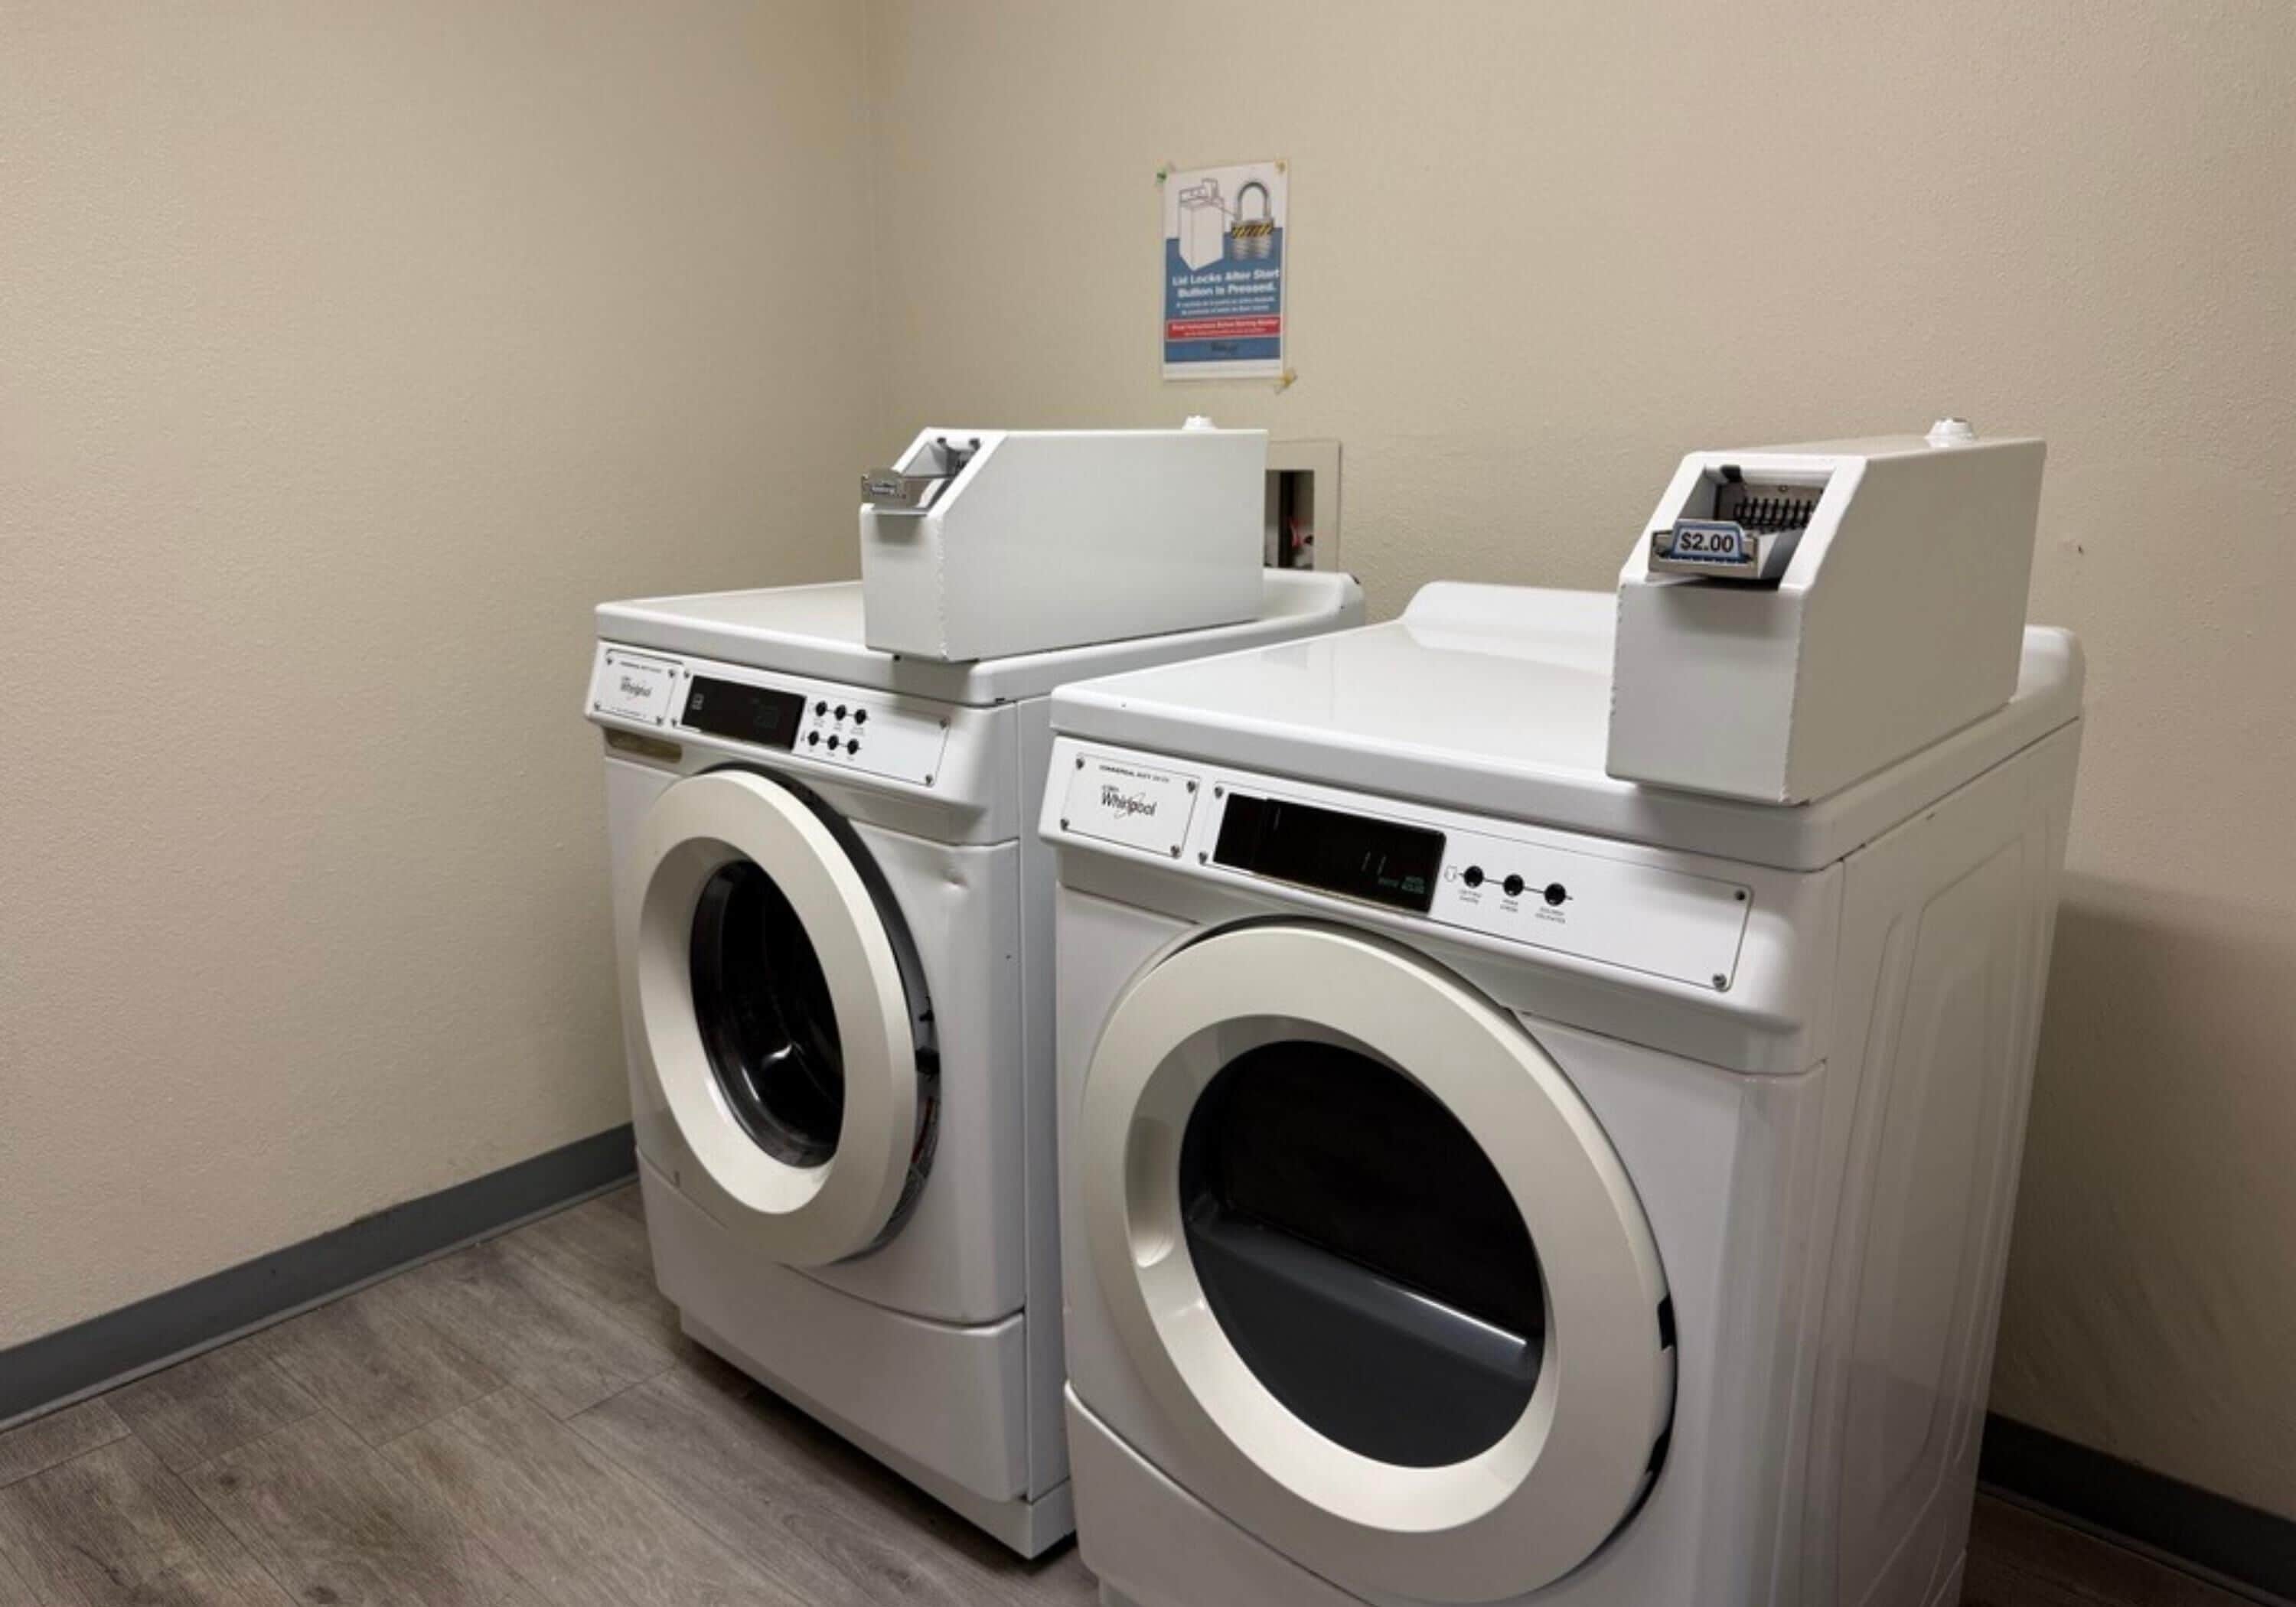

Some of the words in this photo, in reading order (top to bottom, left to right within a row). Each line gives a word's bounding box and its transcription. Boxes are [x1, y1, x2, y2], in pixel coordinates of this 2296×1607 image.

[1172, 275, 1188, 286] Lid
[1190, 273, 1222, 285] Locks
[1225, 271, 1251, 281] After
[1253, 269, 1280, 280] Start
[1177, 287, 1214, 298] Button
[1680, 531, 1733, 553] $2.00
[1101, 791, 1157, 817] Whirlpool
